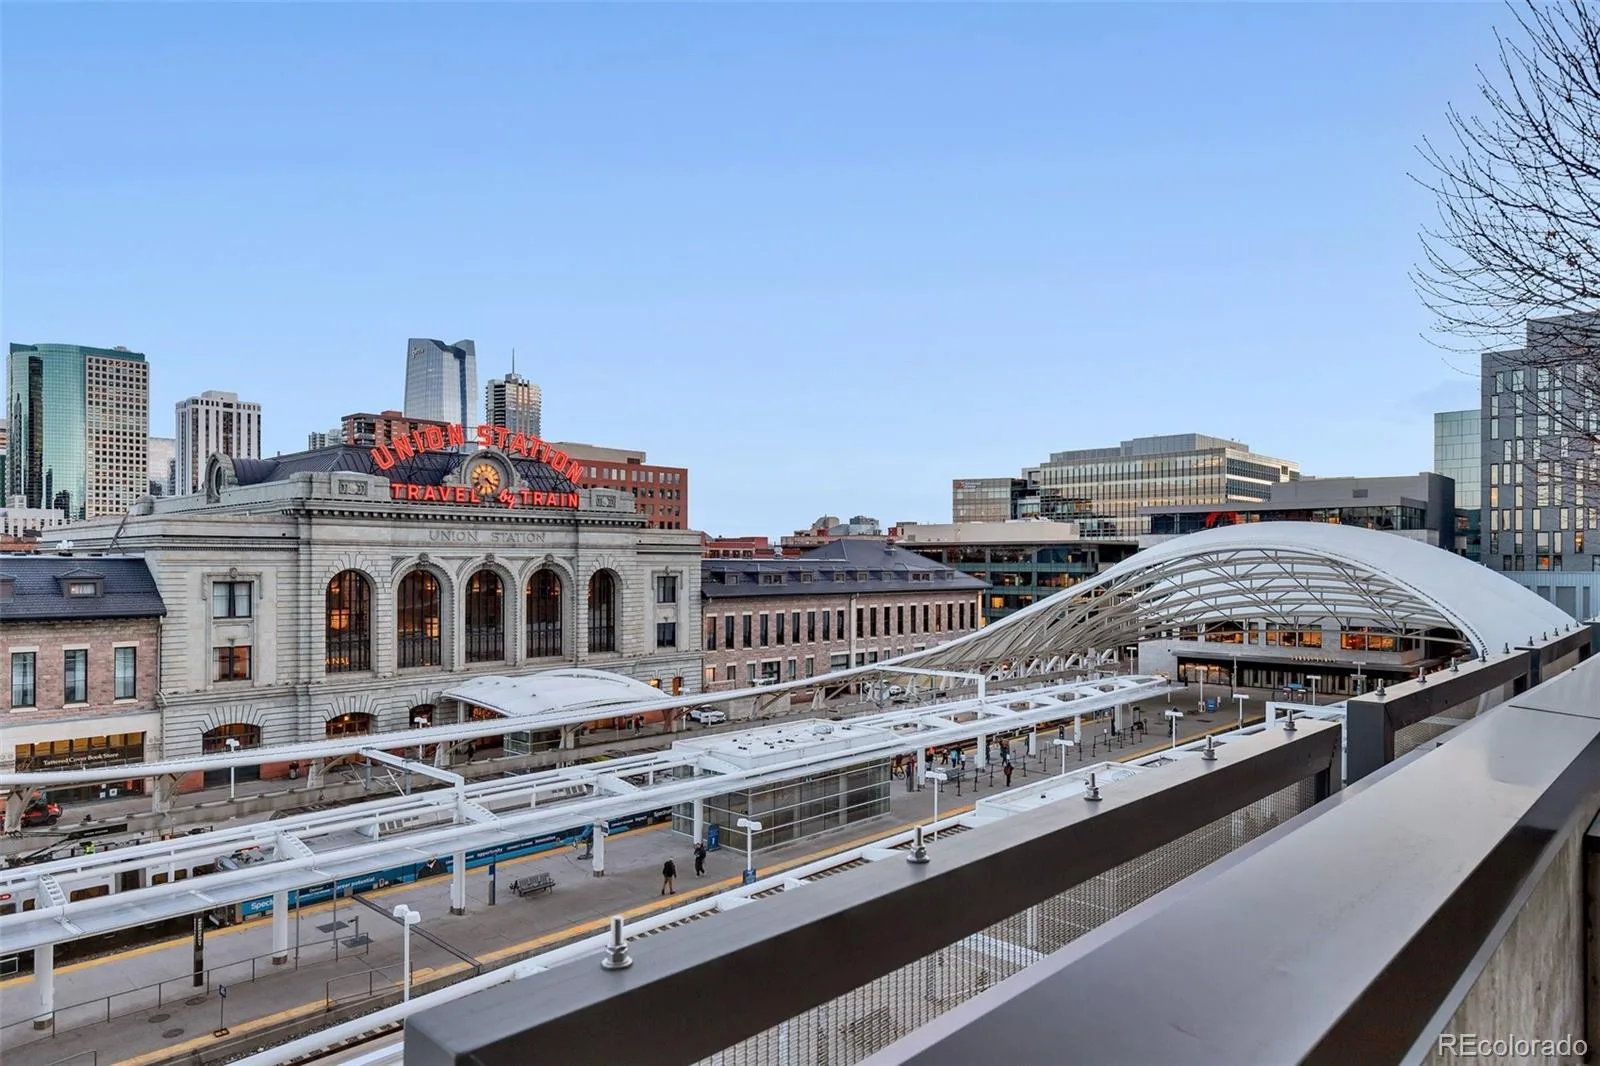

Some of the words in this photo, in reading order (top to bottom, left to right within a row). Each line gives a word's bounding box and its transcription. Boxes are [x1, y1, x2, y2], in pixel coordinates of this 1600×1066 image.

[370, 424, 464, 470] UNION
[477, 425, 585, 485] STATION
[391, 483, 480, 503] TRAVEL
[498, 488, 517, 509] by
[521, 490, 580, 508] TRAIN
[428, 529, 479, 542] UNION
[490, 531, 546, 544] STATION
[43, 758, 69, 767] Tattered
[69, 755, 87, 764] Cover
[87, 754, 103, 762] Book
[103, 752, 119, 760] Store
